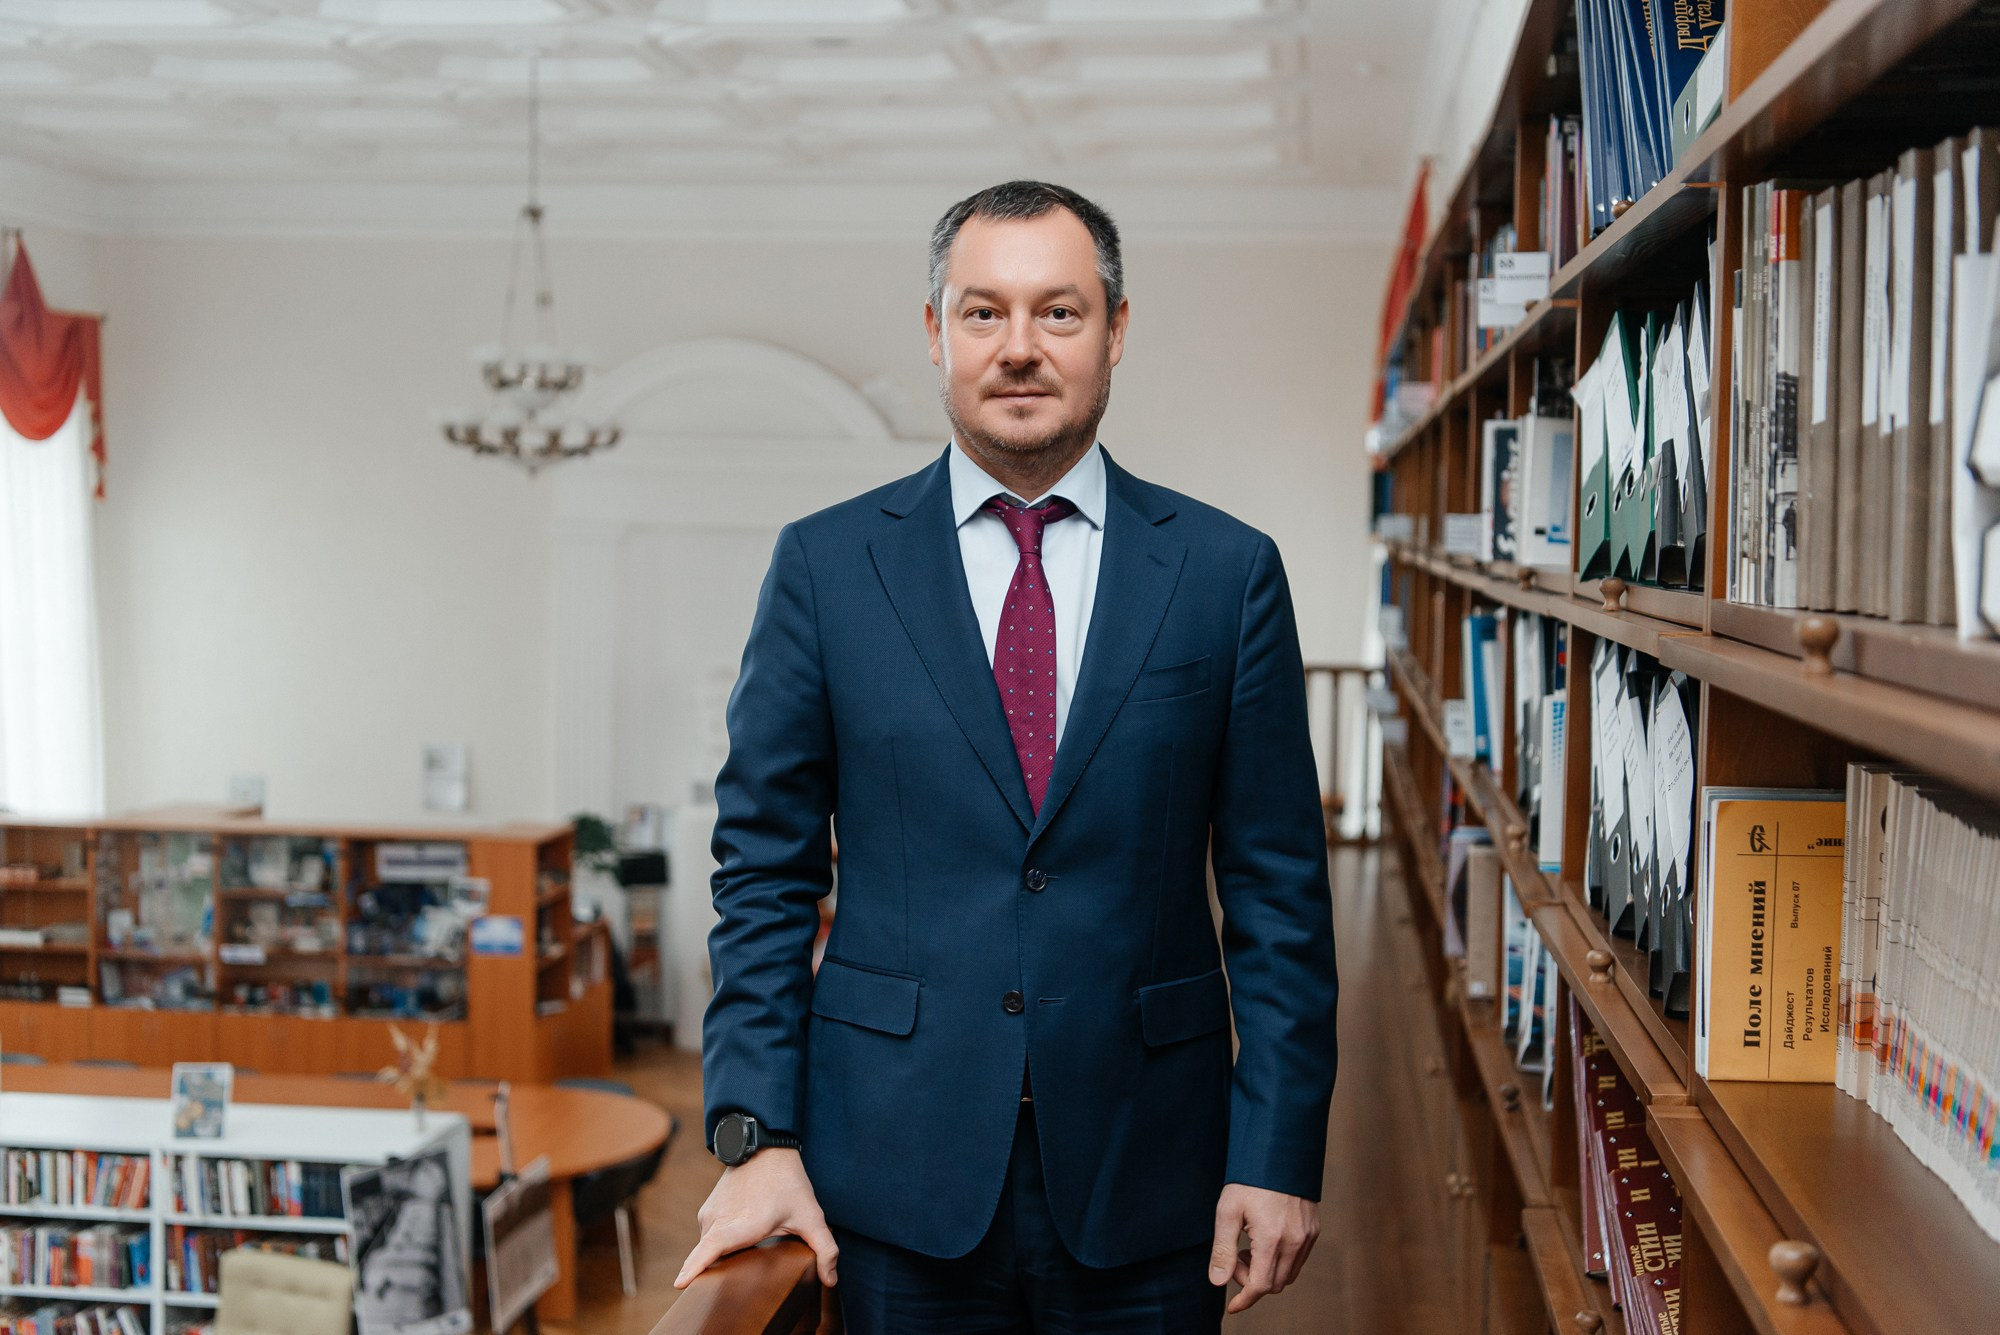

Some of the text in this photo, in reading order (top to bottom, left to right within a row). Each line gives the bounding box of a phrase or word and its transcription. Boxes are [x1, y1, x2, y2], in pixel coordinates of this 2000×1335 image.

[1697, 0, 1723, 30] Уса
[1790, 881, 1802, 929] Выпуск 07
[1743, 880, 1766, 1048] Поле мнений
[1820, 946, 1832, 1033] Исследований
[1783, 991, 1796, 1050] Дайджест
[1802, 967, 1815, 1041] Результатов
